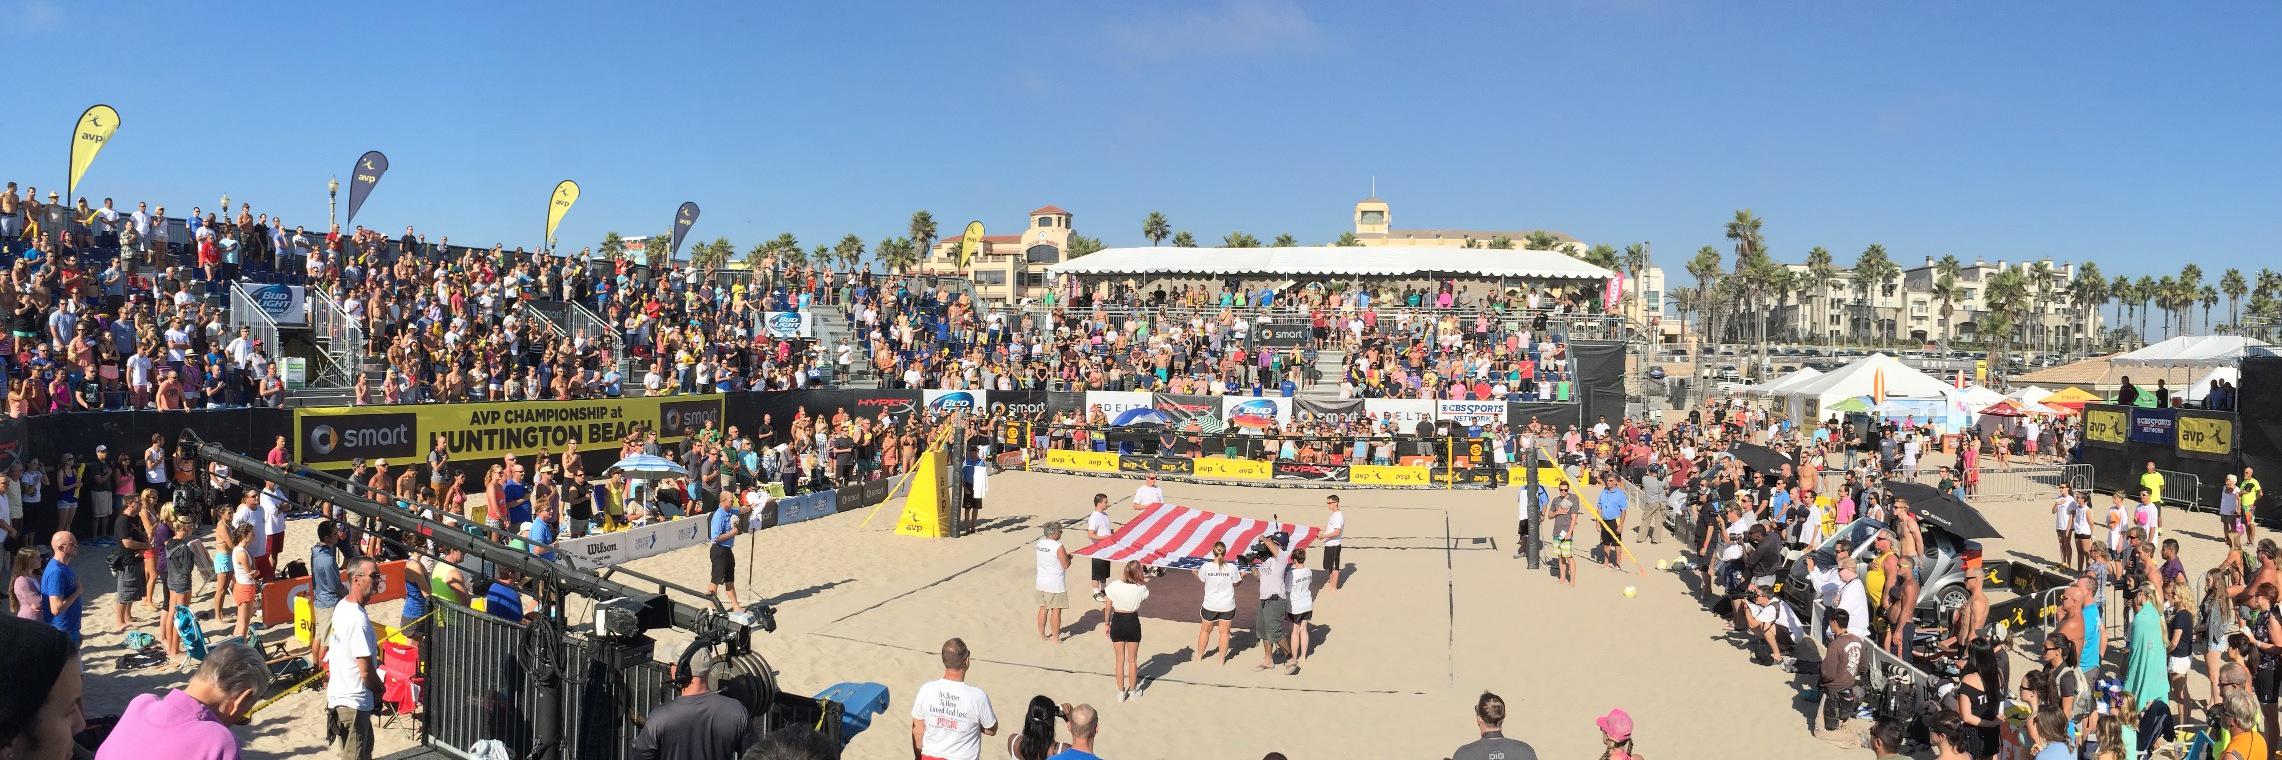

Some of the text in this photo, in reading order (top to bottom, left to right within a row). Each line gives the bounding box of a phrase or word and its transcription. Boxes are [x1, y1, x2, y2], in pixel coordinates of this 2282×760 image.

[82, 132, 103, 143] avp
[358, 174, 376, 184] avp
[679, 218, 692, 226] avp
[262, 292, 288, 300] BUD
[1008, 401, 1048, 414] smart
[470, 405, 623, 426] AVP CHAMPIONSHIP at
[683, 406, 718, 426] smart
[2089, 421, 2106, 433] avp
[343, 424, 408, 448] smart
[2182, 428, 2204, 446] avp
[1122, 461, 1138, 470] avp
[1161, 463, 1176, 472] avp
[1198, 465, 1213, 473] avp
[1354, 472, 1370, 480] avp
[1930, 514, 1952, 527] smart
[587, 542, 618, 555] Wilson
[2014, 576, 2027, 589] avp
